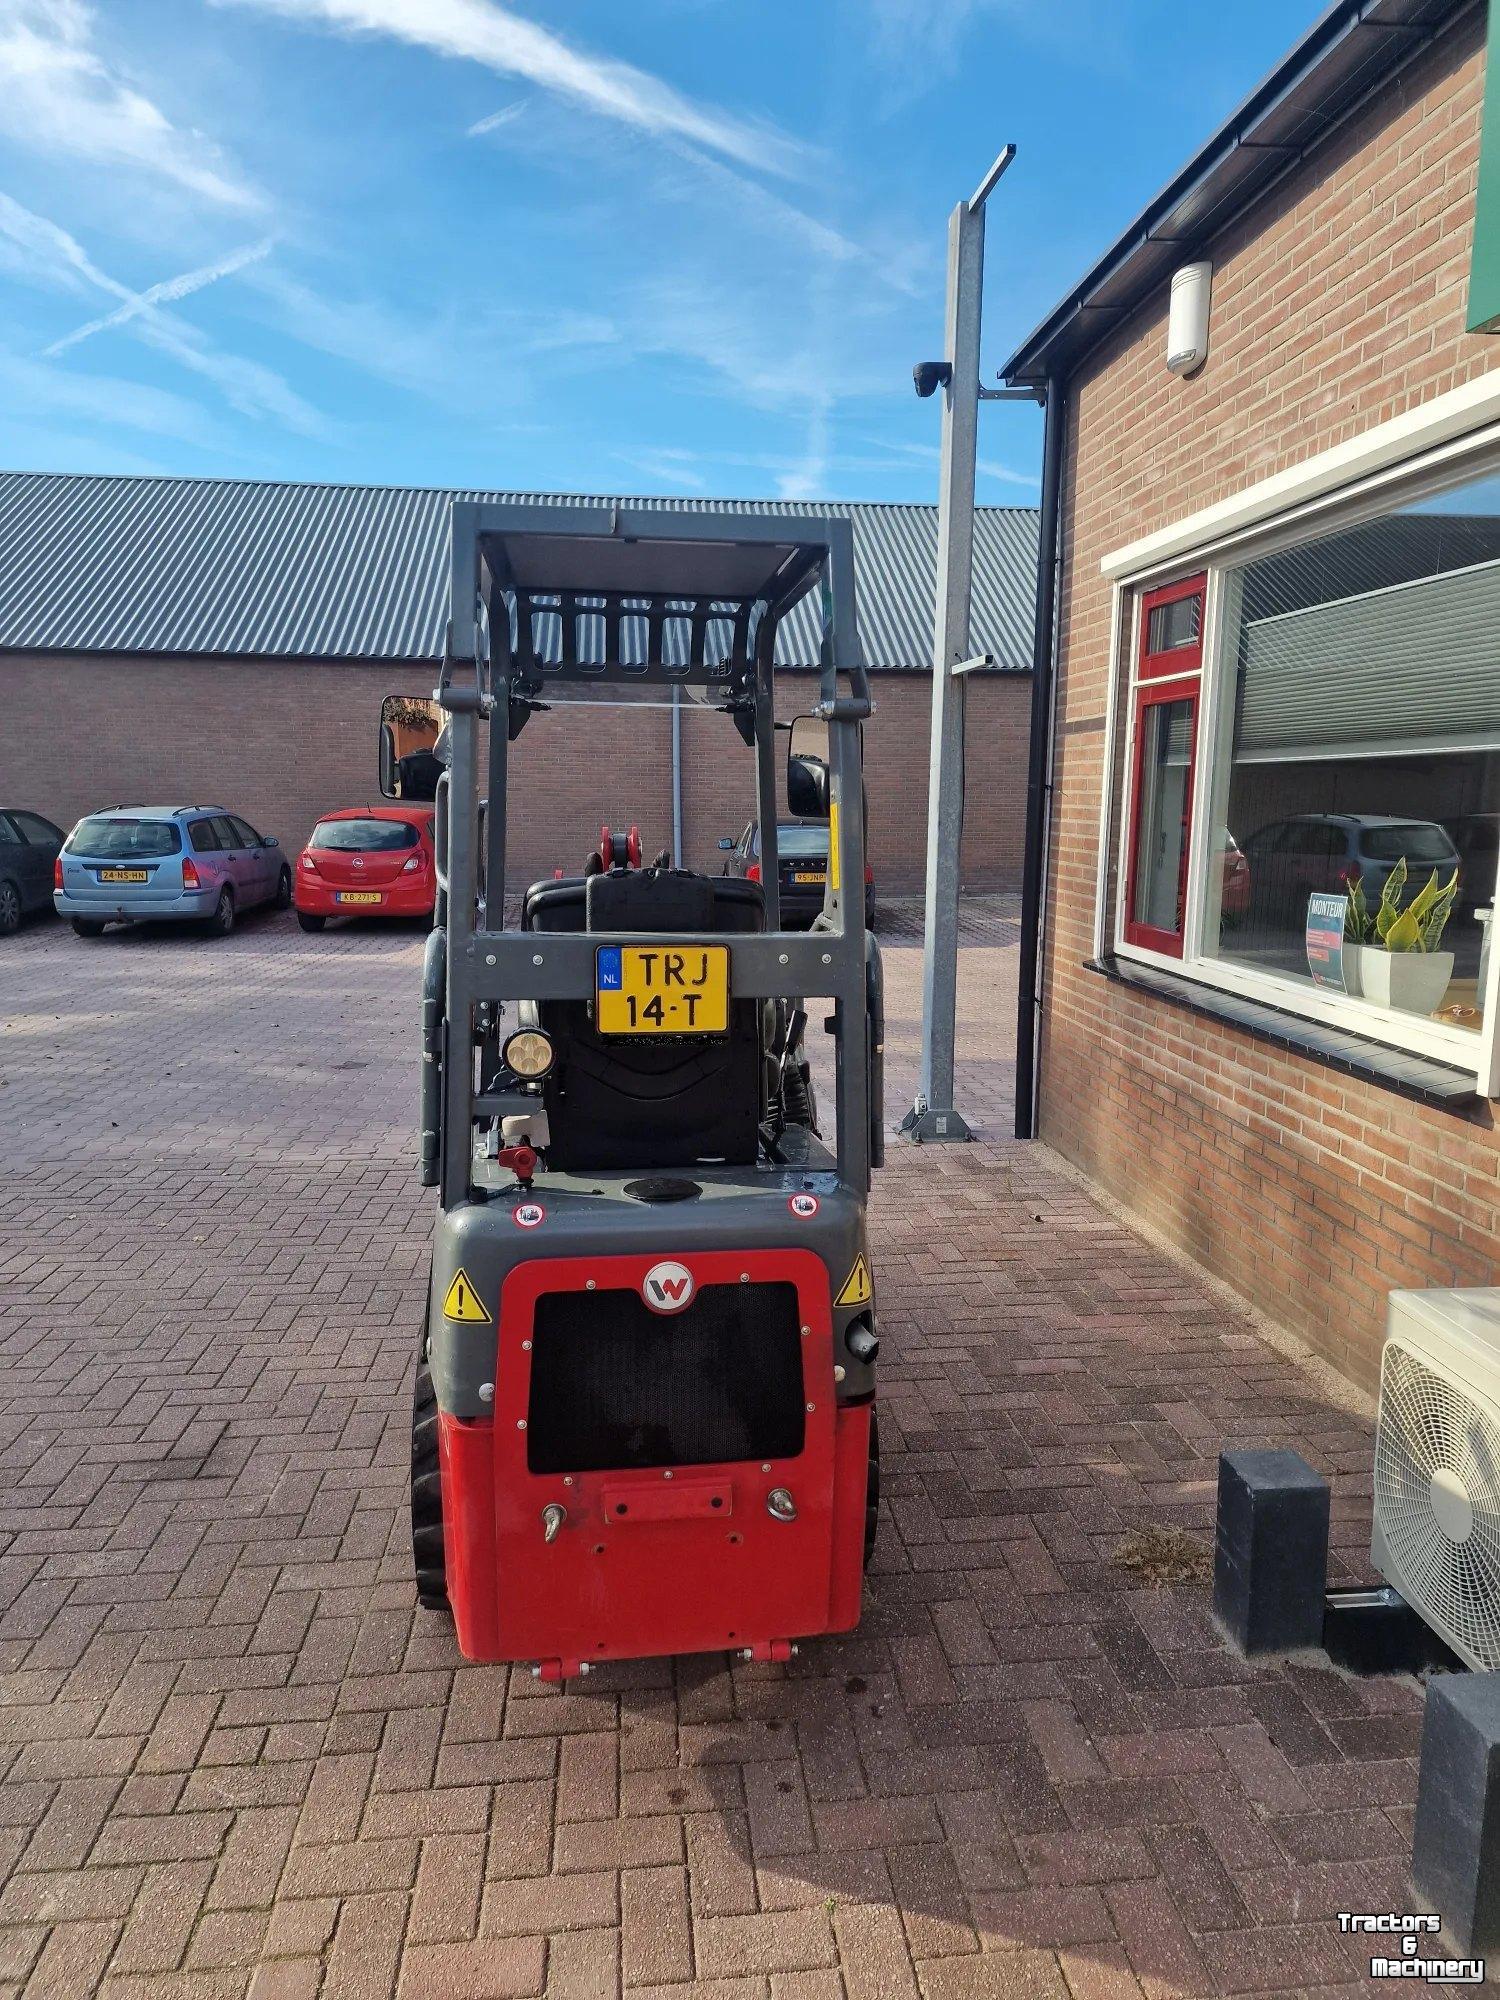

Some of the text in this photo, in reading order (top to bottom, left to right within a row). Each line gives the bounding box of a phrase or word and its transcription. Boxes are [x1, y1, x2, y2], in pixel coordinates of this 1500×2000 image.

[103, 871, 144, 880] 24-NS-HN
[1311, 899, 1344, 919] MONTEUR
[603, 974, 618, 984] NL
[638, 953, 708, 986] TRJ
[626, 993, 702, 1027] 14-T
[648, 1278, 689, 1301] W
